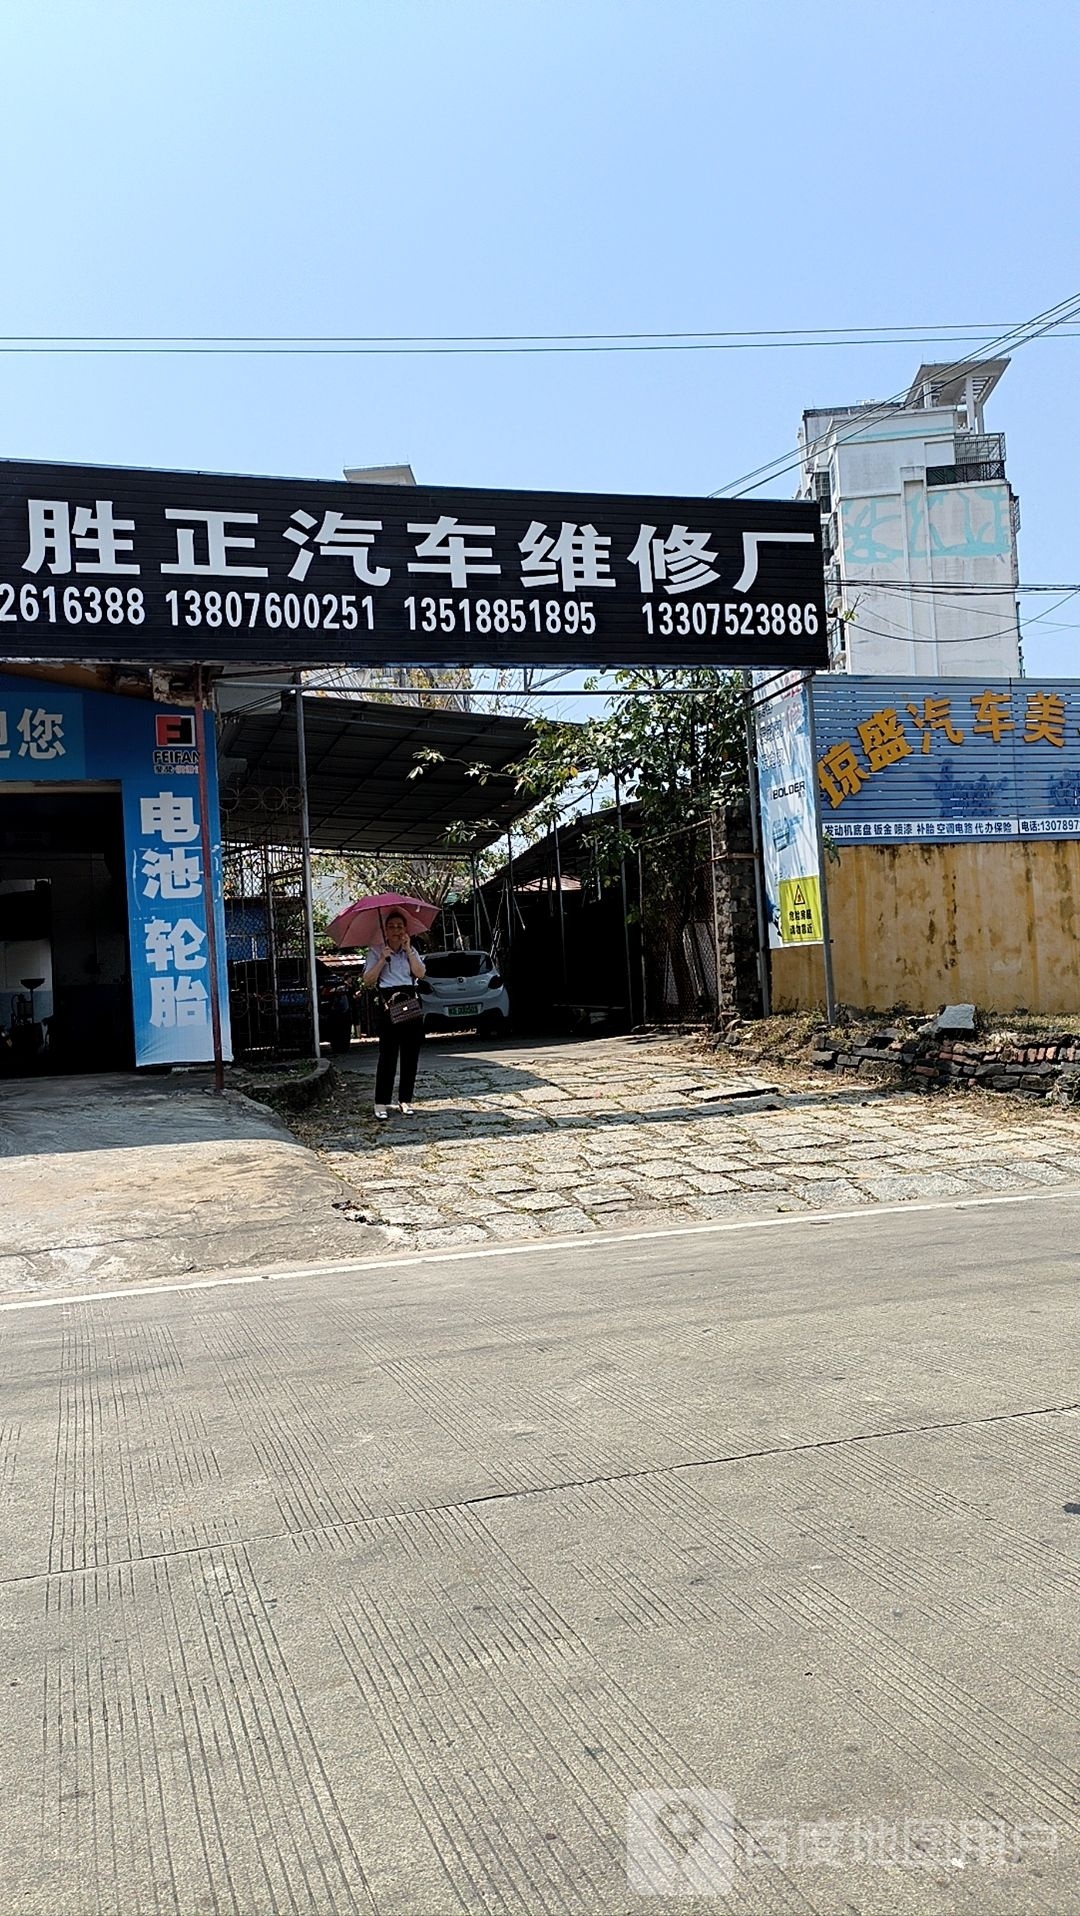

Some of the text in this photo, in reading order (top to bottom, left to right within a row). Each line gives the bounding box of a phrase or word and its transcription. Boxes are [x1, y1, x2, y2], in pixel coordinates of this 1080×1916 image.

[21, 498, 815, 594] 胜正汽车维修厂
[0, 583, 819, 635] 2616388 13807600251 13518851895 13307523886
[772, 780, 806, 800] BOLDER
[825, 823, 872, 837] 发动机底盘
[916, 822, 935, 835] 补胎
[936, 822, 973, 835] 空调电路
[975, 821, 1012, 834] 代办保险
